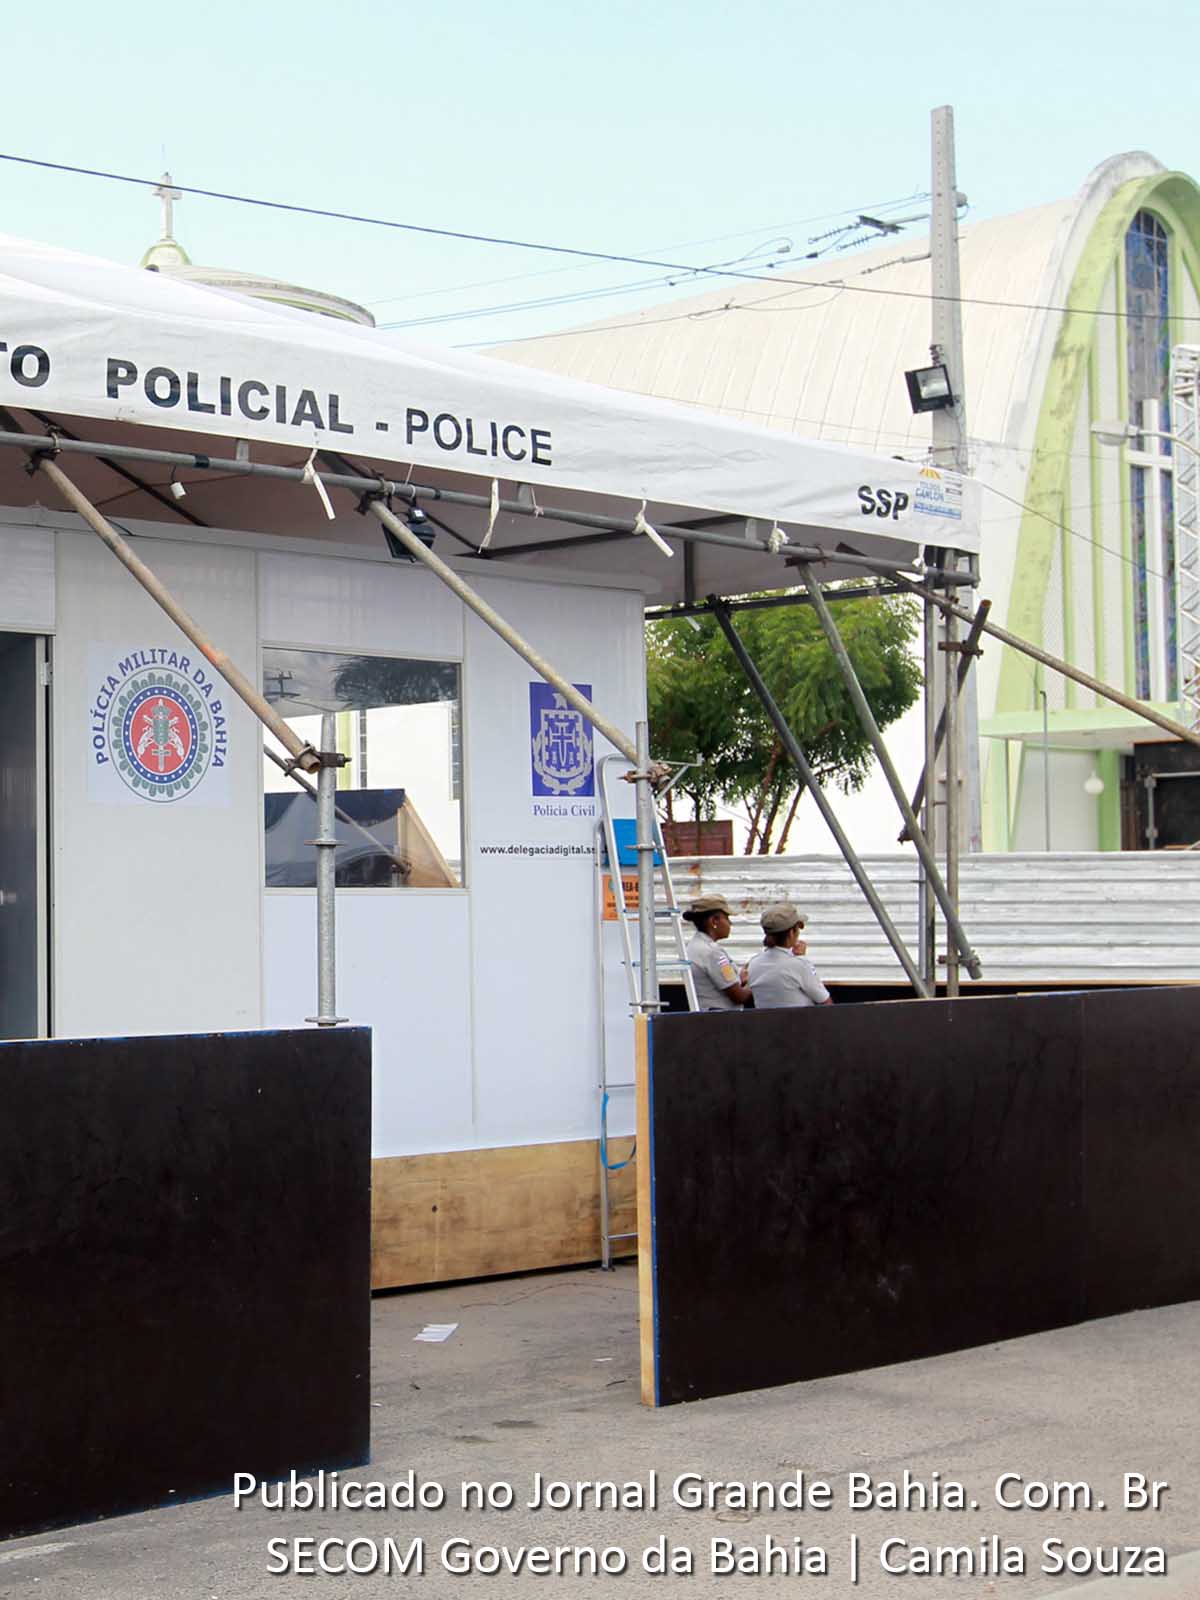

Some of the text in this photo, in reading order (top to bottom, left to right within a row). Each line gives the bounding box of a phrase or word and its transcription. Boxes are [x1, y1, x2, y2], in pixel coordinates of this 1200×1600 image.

[105, 357, 355, 434] POLICIAL
[405, 407, 553, 466] POLICE
[857, 484, 910, 521] SSP
[90, 648, 228, 768] POLÍCIA MILITAR DA BAHIA
[570, 804, 596, 817] Civil
